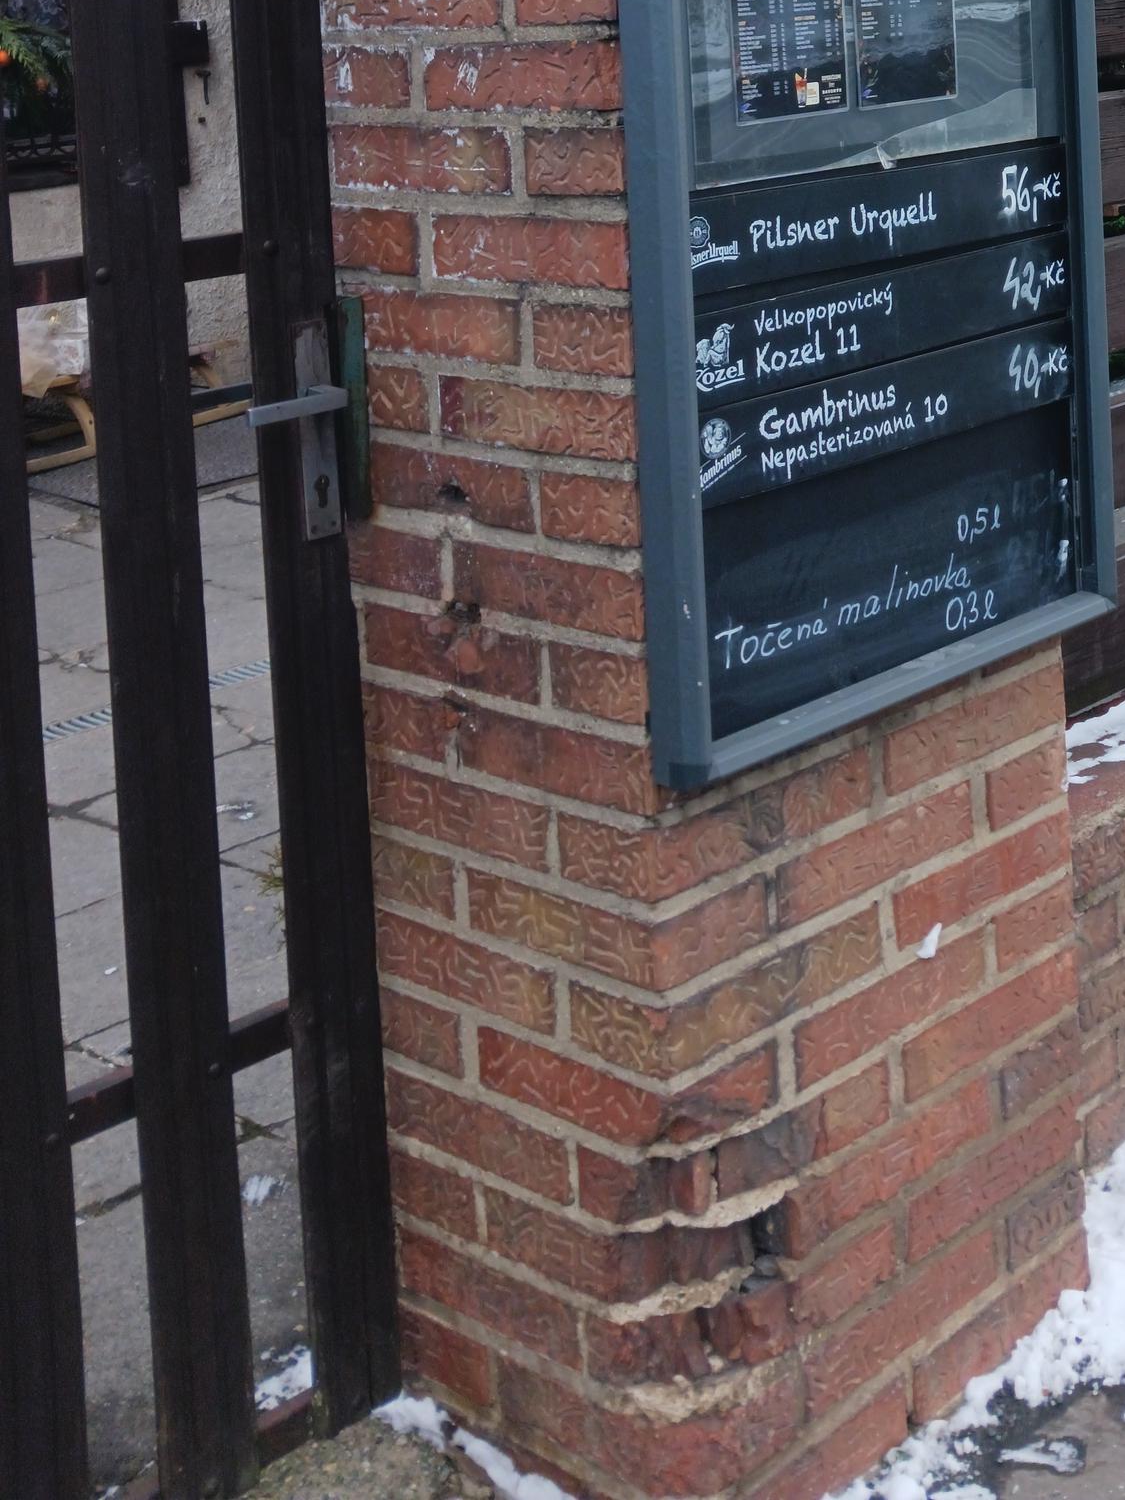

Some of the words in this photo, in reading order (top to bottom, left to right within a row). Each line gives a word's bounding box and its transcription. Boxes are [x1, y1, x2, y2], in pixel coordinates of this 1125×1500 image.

[749, 212, 840, 253] Pilsner
[851, 192, 937, 252] Urquell
[753, 282, 893, 336] Velkopopovický
[755, 337, 826, 378] Kozel
[836, 324, 862, 353] 11
[759, 384, 897, 441] Gambrinus
[760, 411, 916, 479] Nepasterizovaná
[924, 394, 948, 423] 10
[714, 601, 828, 670] Točená
[837, 553, 972, 627] malinovka
